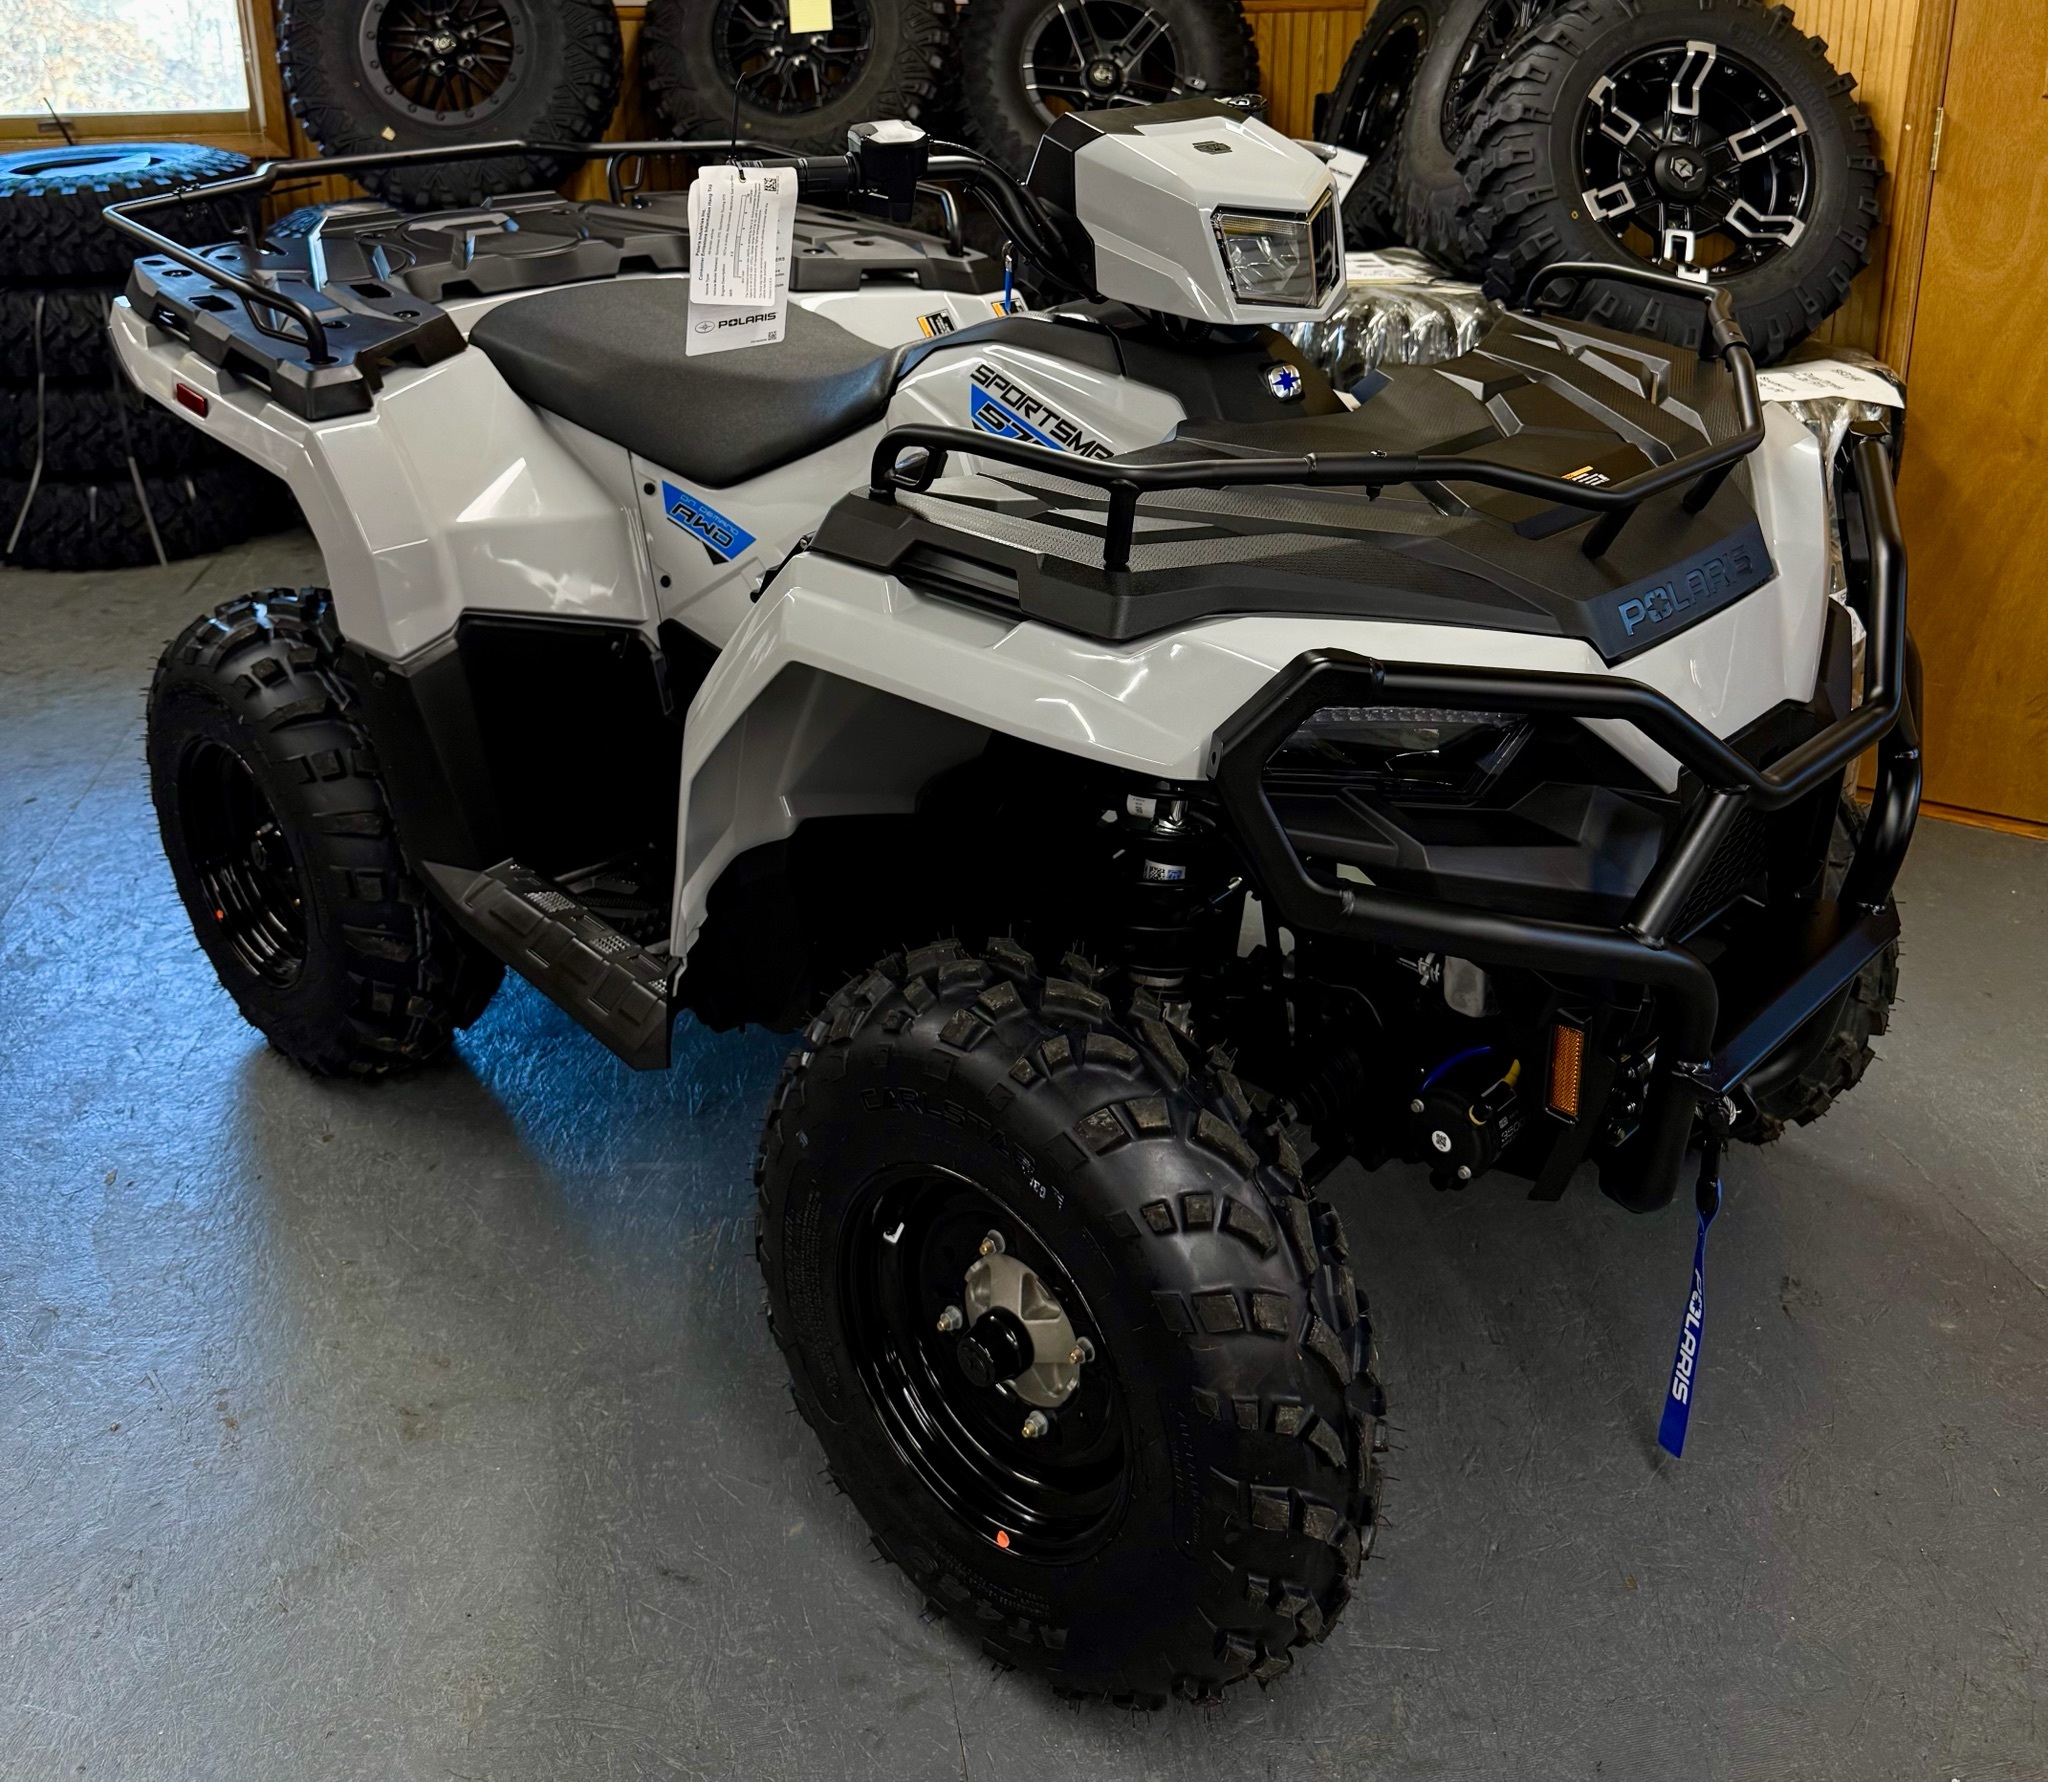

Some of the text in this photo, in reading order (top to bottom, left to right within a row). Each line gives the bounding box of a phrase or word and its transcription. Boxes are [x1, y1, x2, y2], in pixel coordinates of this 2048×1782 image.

[718, 312, 776, 328] POLARIS
[970, 364, 1114, 459] SPORTSMA
[977, 401, 1047, 446] 57
[670, 502, 734, 548] AWD
[698, 506, 739, 536] DEMAND
[1618, 544, 1753, 636] POLARIS
[1672, 1268, 1704, 1406] POLARIS
